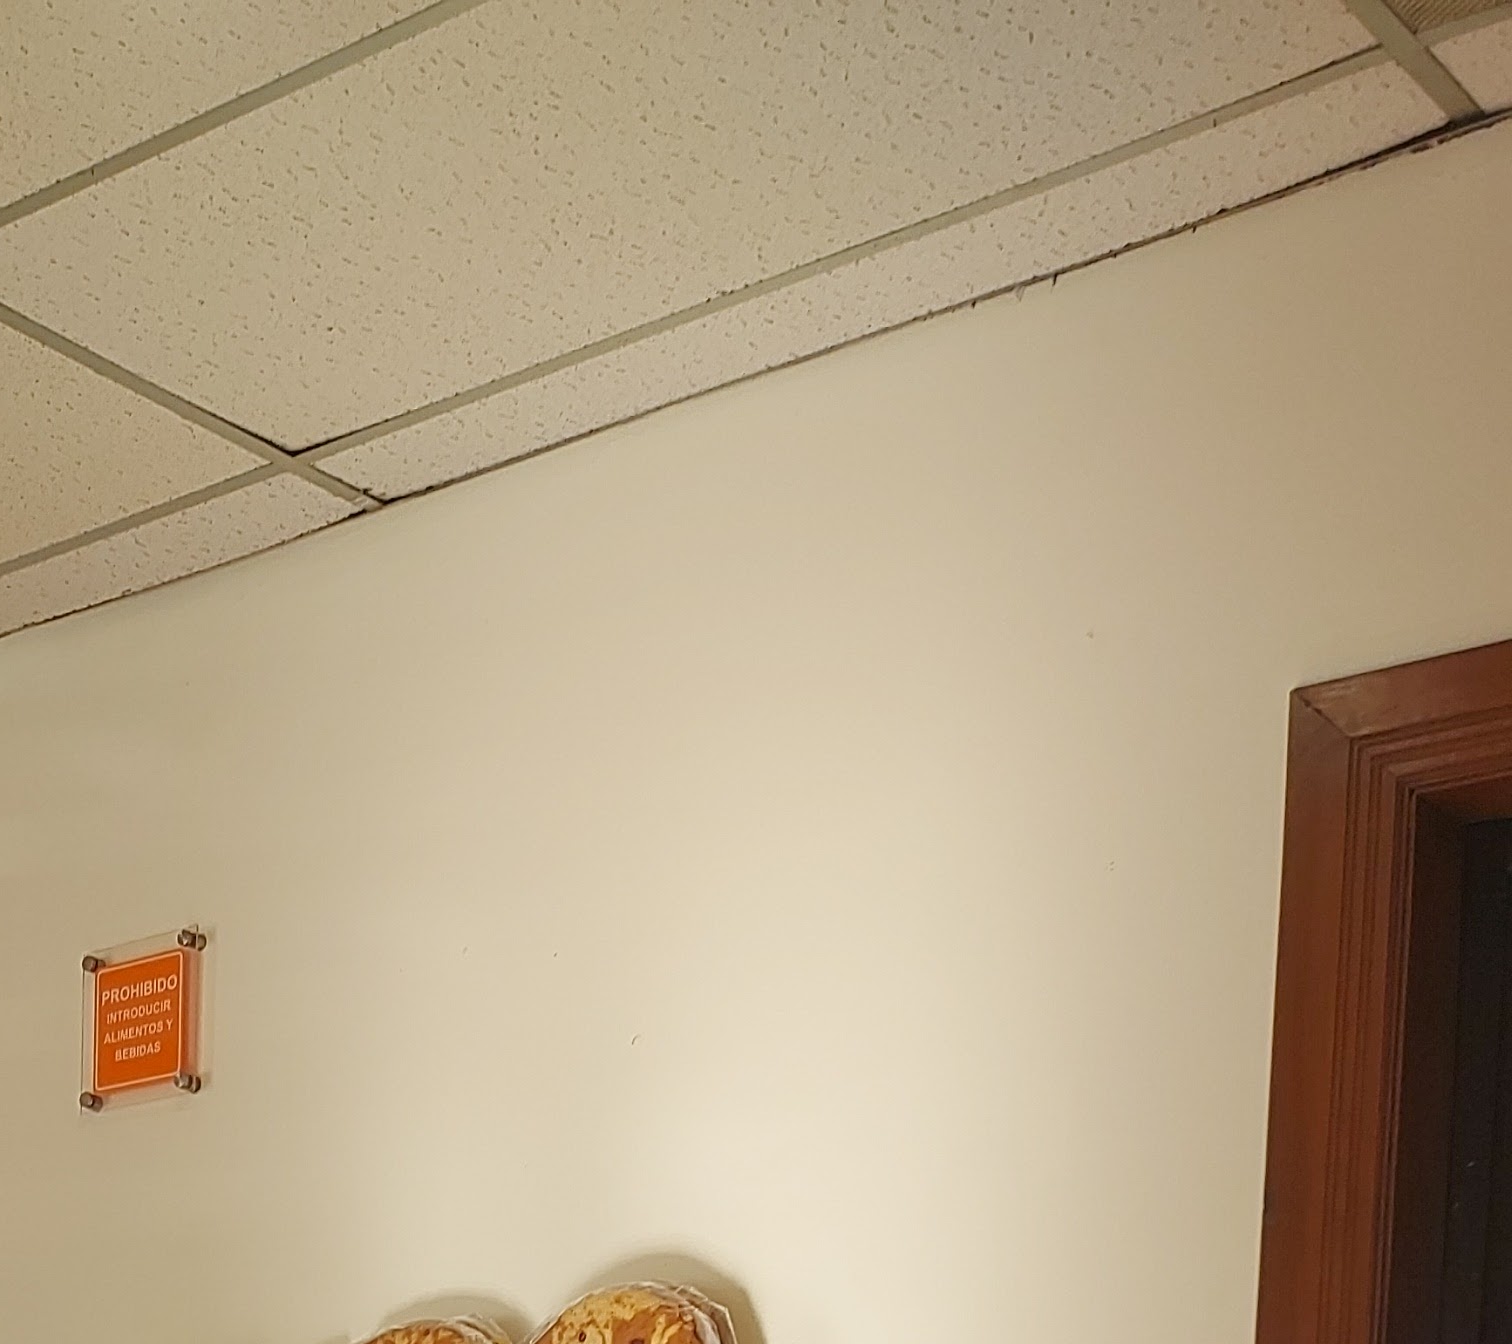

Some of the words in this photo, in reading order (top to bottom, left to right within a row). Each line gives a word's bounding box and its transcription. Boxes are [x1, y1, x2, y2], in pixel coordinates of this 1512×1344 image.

[101, 973, 178, 1006] PROHIBIDO
[106, 999, 172, 1025] INTRODUCIR
[103, 1021, 164, 1044] ALIMENTOS
[165, 1018, 174, 1031] Y
[114, 1041, 162, 1062] BEBIDAS
